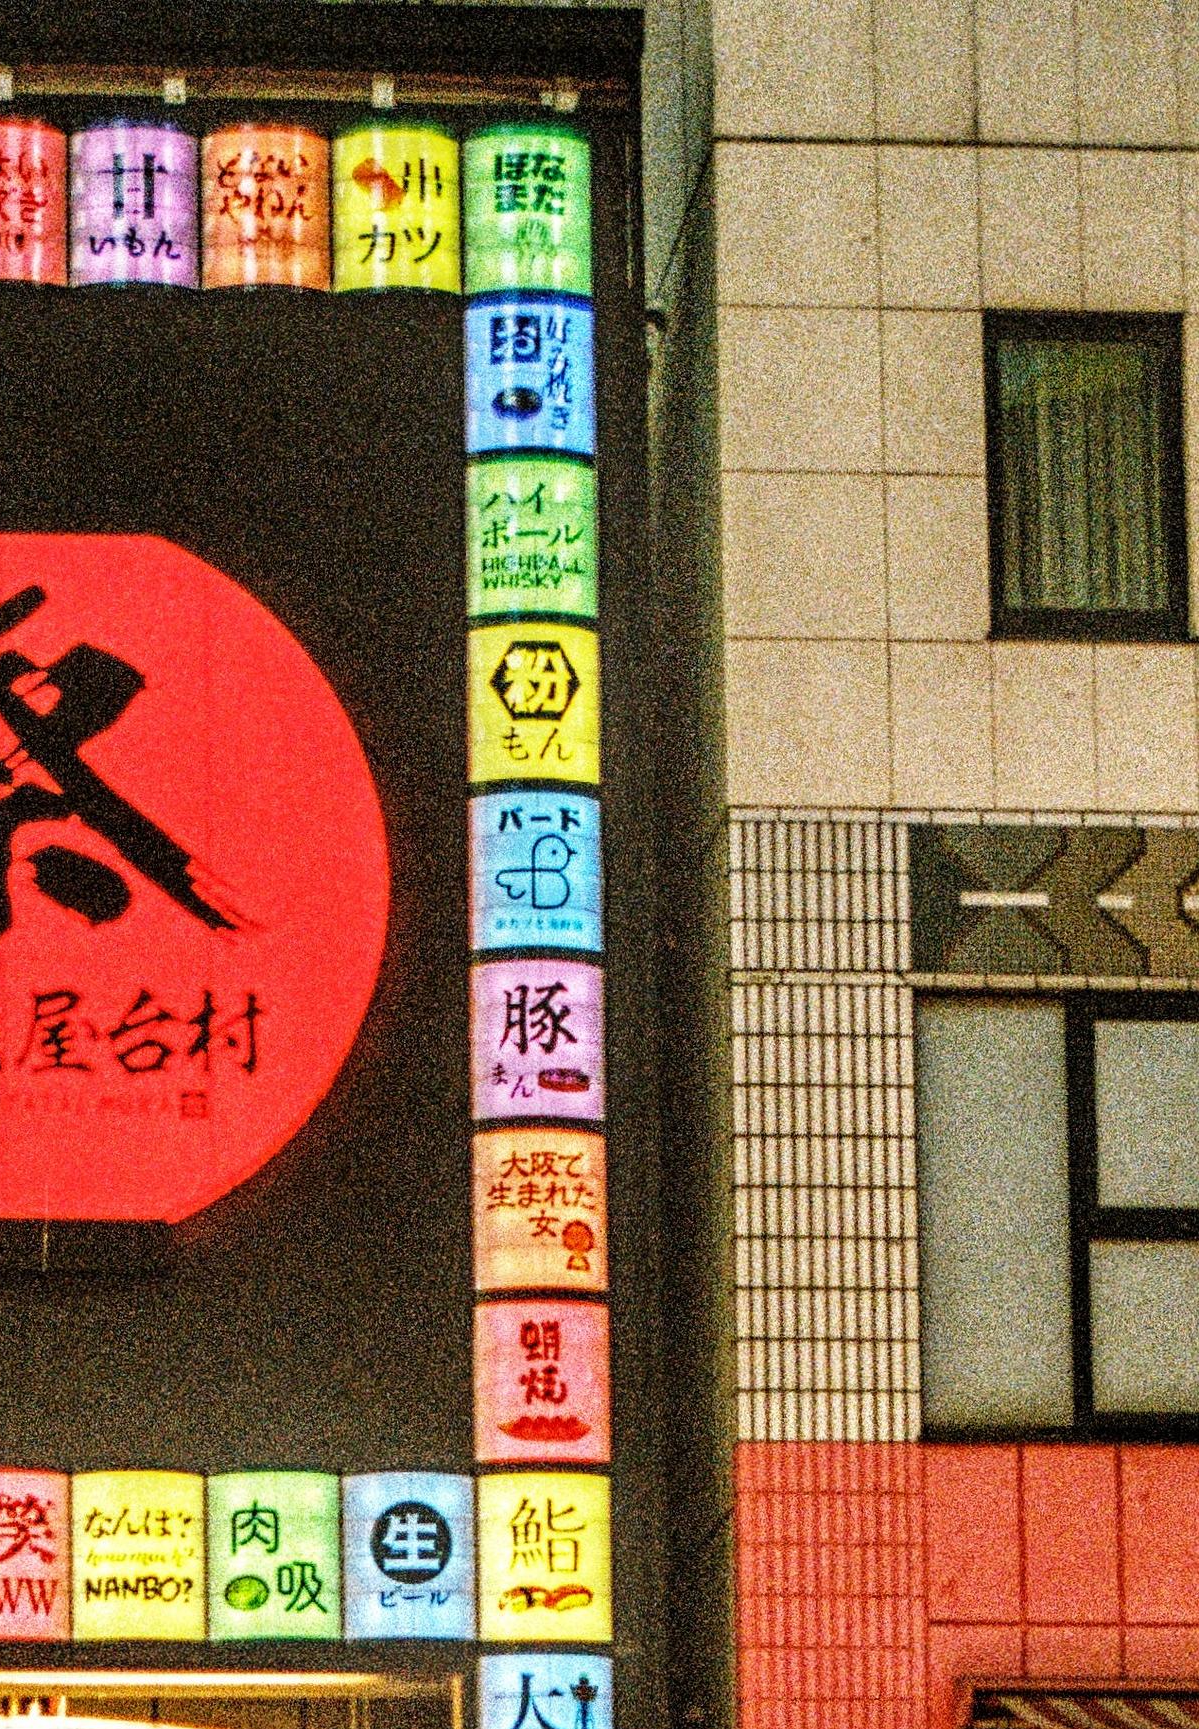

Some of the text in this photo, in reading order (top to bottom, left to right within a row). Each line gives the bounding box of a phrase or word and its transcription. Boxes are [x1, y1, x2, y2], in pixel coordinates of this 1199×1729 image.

[494, 154, 566, 180] ほな
[90, 228, 180, 258] いもん
[359, 224, 442, 263] カツ
[483, 483, 545, 514] ハイ
[483, 518, 583, 548] ボール
[483, 574, 562, 589] WHISKY
[505, 650, 570, 713] 粉
[502, 727, 573, 760] もん
[499, 806, 581, 832] バード
[500, 982, 577, 1054] 豚
[502, 1151, 583, 1178] 大阪で
[487, 1182, 595, 1210] 生まれた
[529, 1210, 560, 1238] 女
[231, 1501, 279, 1555] 肉
[381, 1512, 441, 1571] 生
[510, 1497, 586, 1573] 鮨
[85, 1577, 194, 1603] NANBO?
[278, 1562, 328, 1613] 吸
[378, 1588, 450, 1607] ビール
